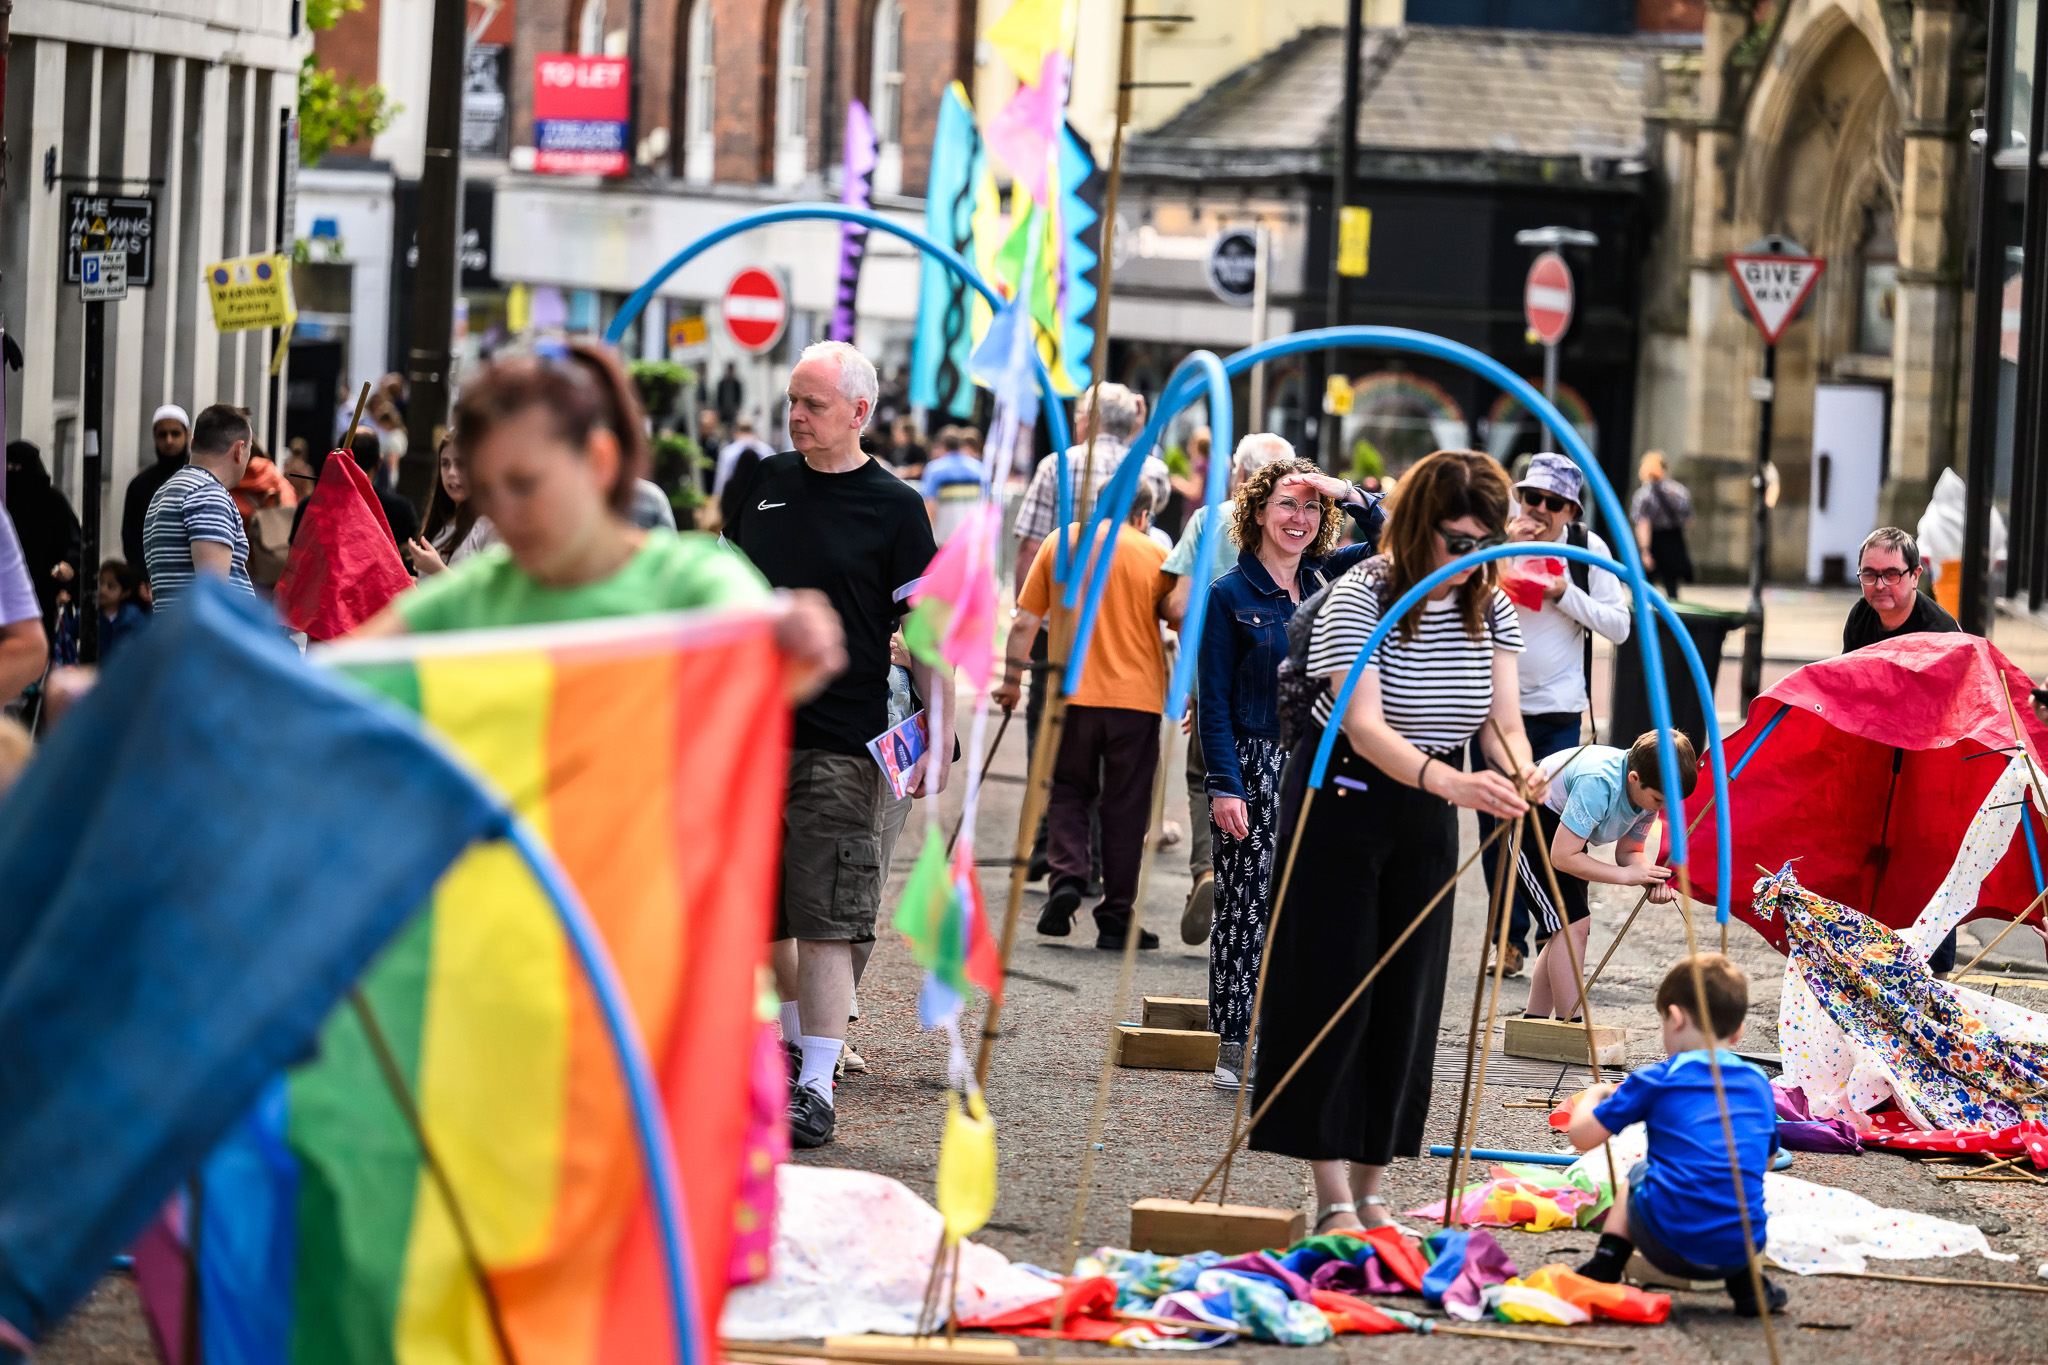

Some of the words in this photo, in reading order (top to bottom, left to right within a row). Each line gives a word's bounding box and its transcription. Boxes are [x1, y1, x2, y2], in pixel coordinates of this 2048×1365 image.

[538, 61, 575, 88] TO
[576, 63, 625, 89] LET
[71, 198, 108, 217] THE
[1745, 263, 1801, 286] GIVE
[216, 283, 278, 302] WARNING
[1755, 287, 1791, 302] WAY
